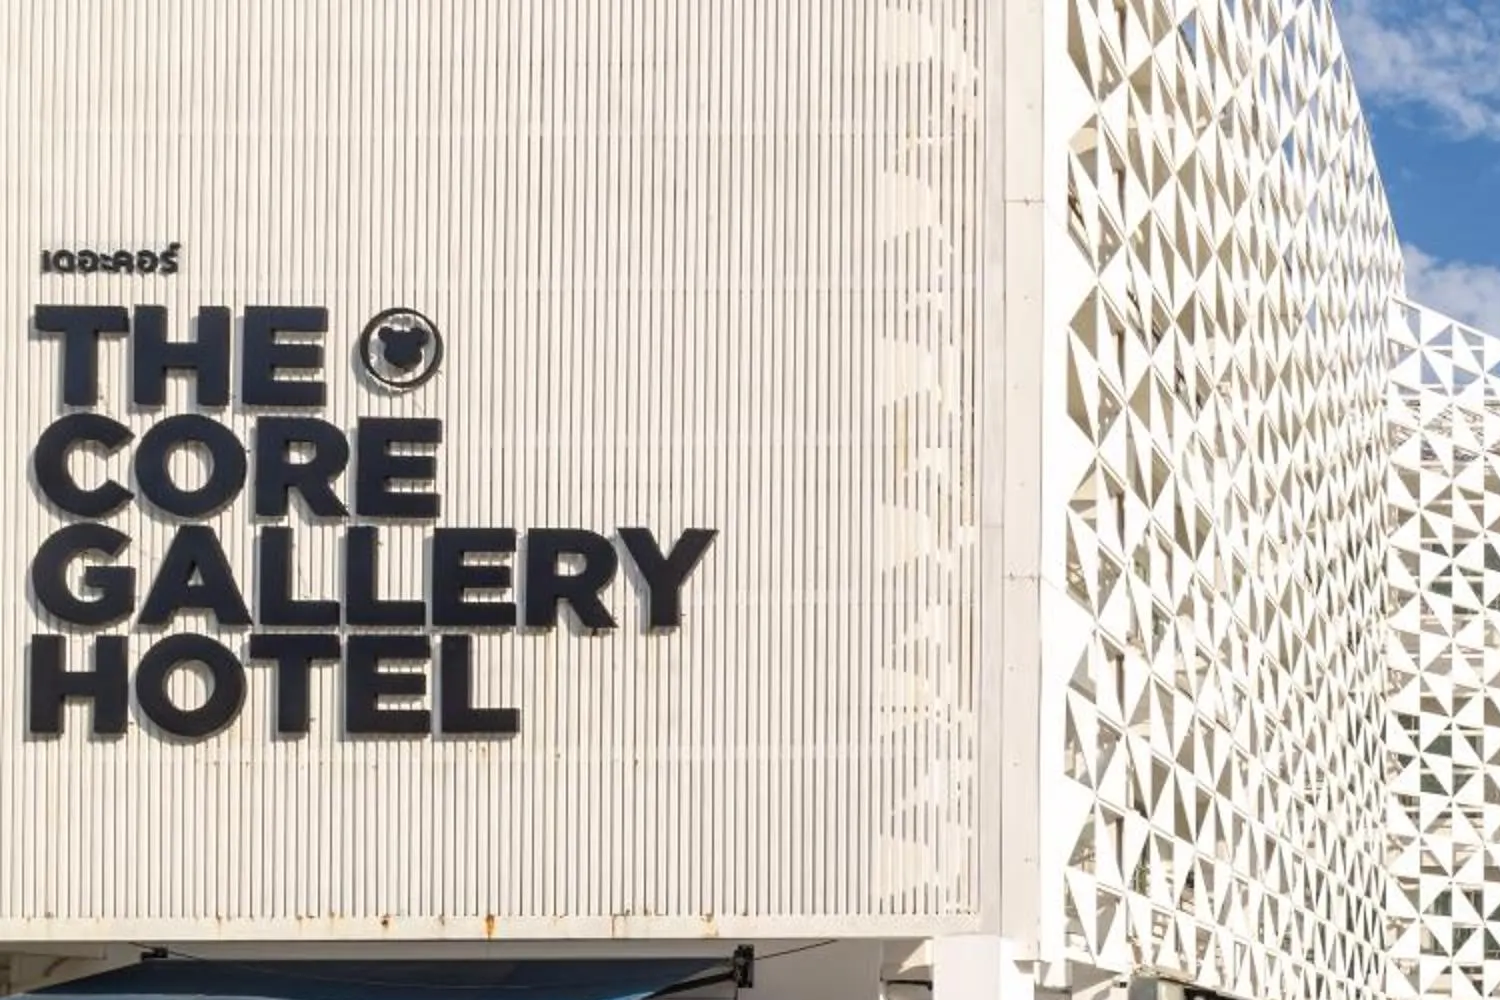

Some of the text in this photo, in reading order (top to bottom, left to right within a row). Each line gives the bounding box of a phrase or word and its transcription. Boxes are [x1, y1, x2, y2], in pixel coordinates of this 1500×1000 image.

[35, 305, 328, 407] THE
[34, 412, 443, 519] CORE
[32, 523, 718, 630] GALLERY
[29, 633, 519, 738] HOTEL
